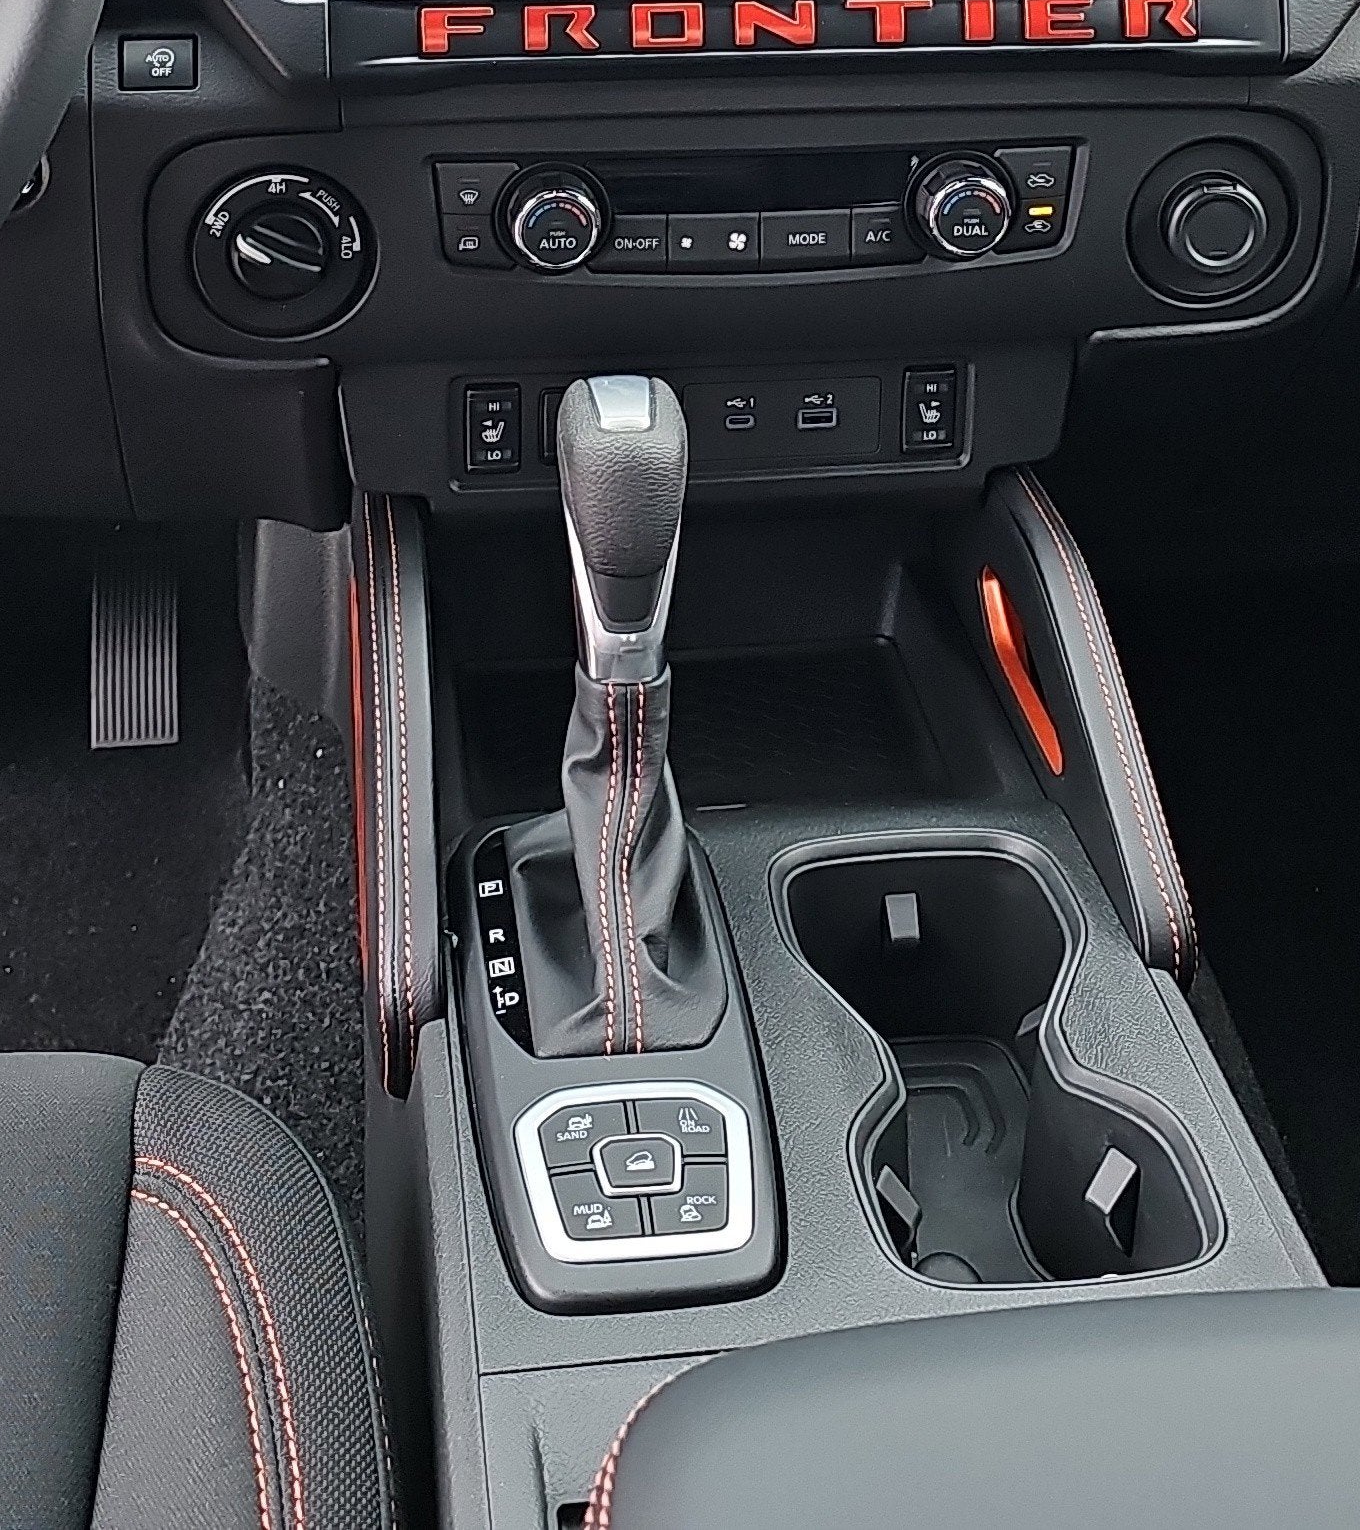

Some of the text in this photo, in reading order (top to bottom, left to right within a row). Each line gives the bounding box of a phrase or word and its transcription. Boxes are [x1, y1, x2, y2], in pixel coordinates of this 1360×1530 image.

[145, 54, 169, 64] AUTO
[151, 66, 172, 77] OFF
[268, 182, 286, 194] 4H
[316, 189, 341, 212] PUSH
[210, 211, 230, 238] 2WD
[865, 229, 891, 243] A/C
[953, 225, 989, 236] DUAL
[540, 238, 576, 249] AUTO
[788, 232, 827, 246] MODE
[341, 235, 353, 259] 4LO
[926, 383, 937, 392] HI
[488, 401, 500, 412] HI
[923, 430, 937, 440] LO
[487, 449, 501, 460] LO
[484, 882, 498, 895] P
[489, 929, 505, 943] R
[494, 960, 510, 974] N
[506, 991, 519, 1005] D
[680, 1120, 695, 1129] ON
[681, 1124, 710, 1134] ROAD
[556, 1129, 588, 1141] SAND
[686, 1195, 717, 1205] ROCK
[573, 1204, 603, 1215] MUD
